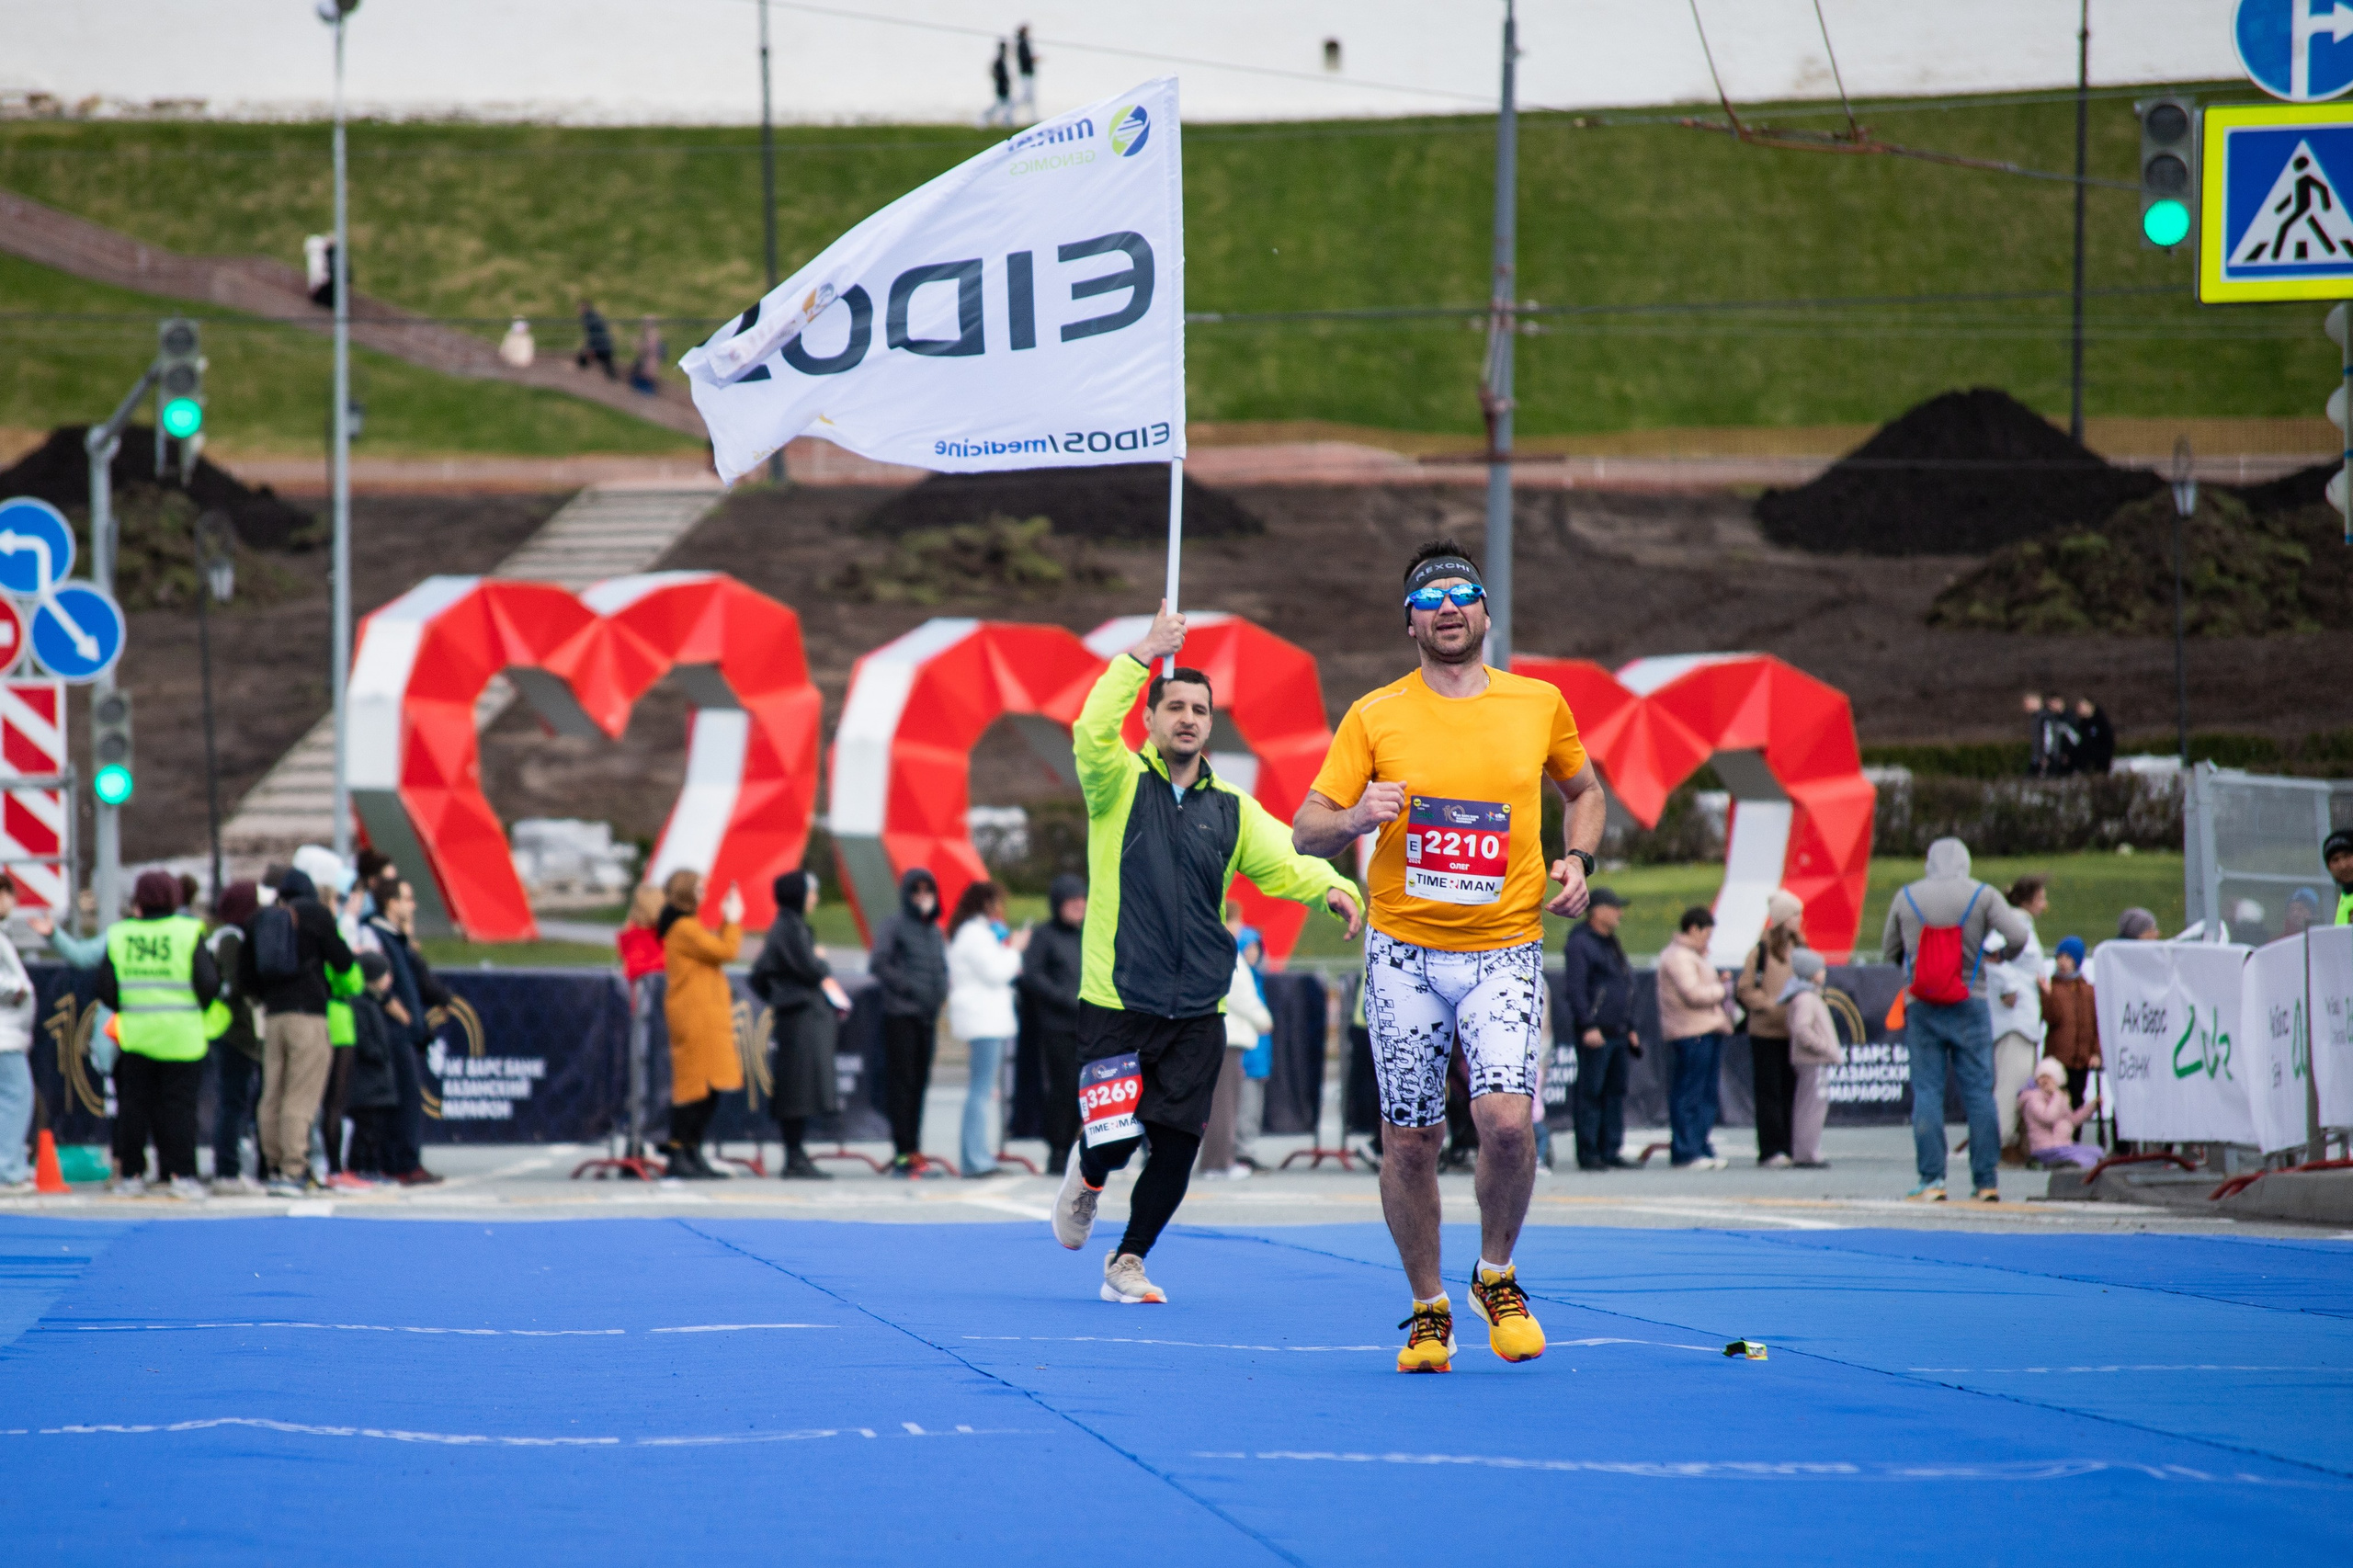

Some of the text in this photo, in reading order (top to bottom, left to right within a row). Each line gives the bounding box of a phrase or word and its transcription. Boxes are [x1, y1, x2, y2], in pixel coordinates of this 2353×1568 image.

[1415, 562, 1470, 582] REXCHI
[1409, 830, 1500, 859] E 2210
[1449, 861, 1471, 871] ОЛЕГ
[1850, 1043, 1892, 1064] БАРС
[1825, 1064, 1911, 1083] КАЗАНСКИ
[1086, 1079, 1138, 1109] 3269
[1827, 1083, 1903, 1102] МАРАФОН
